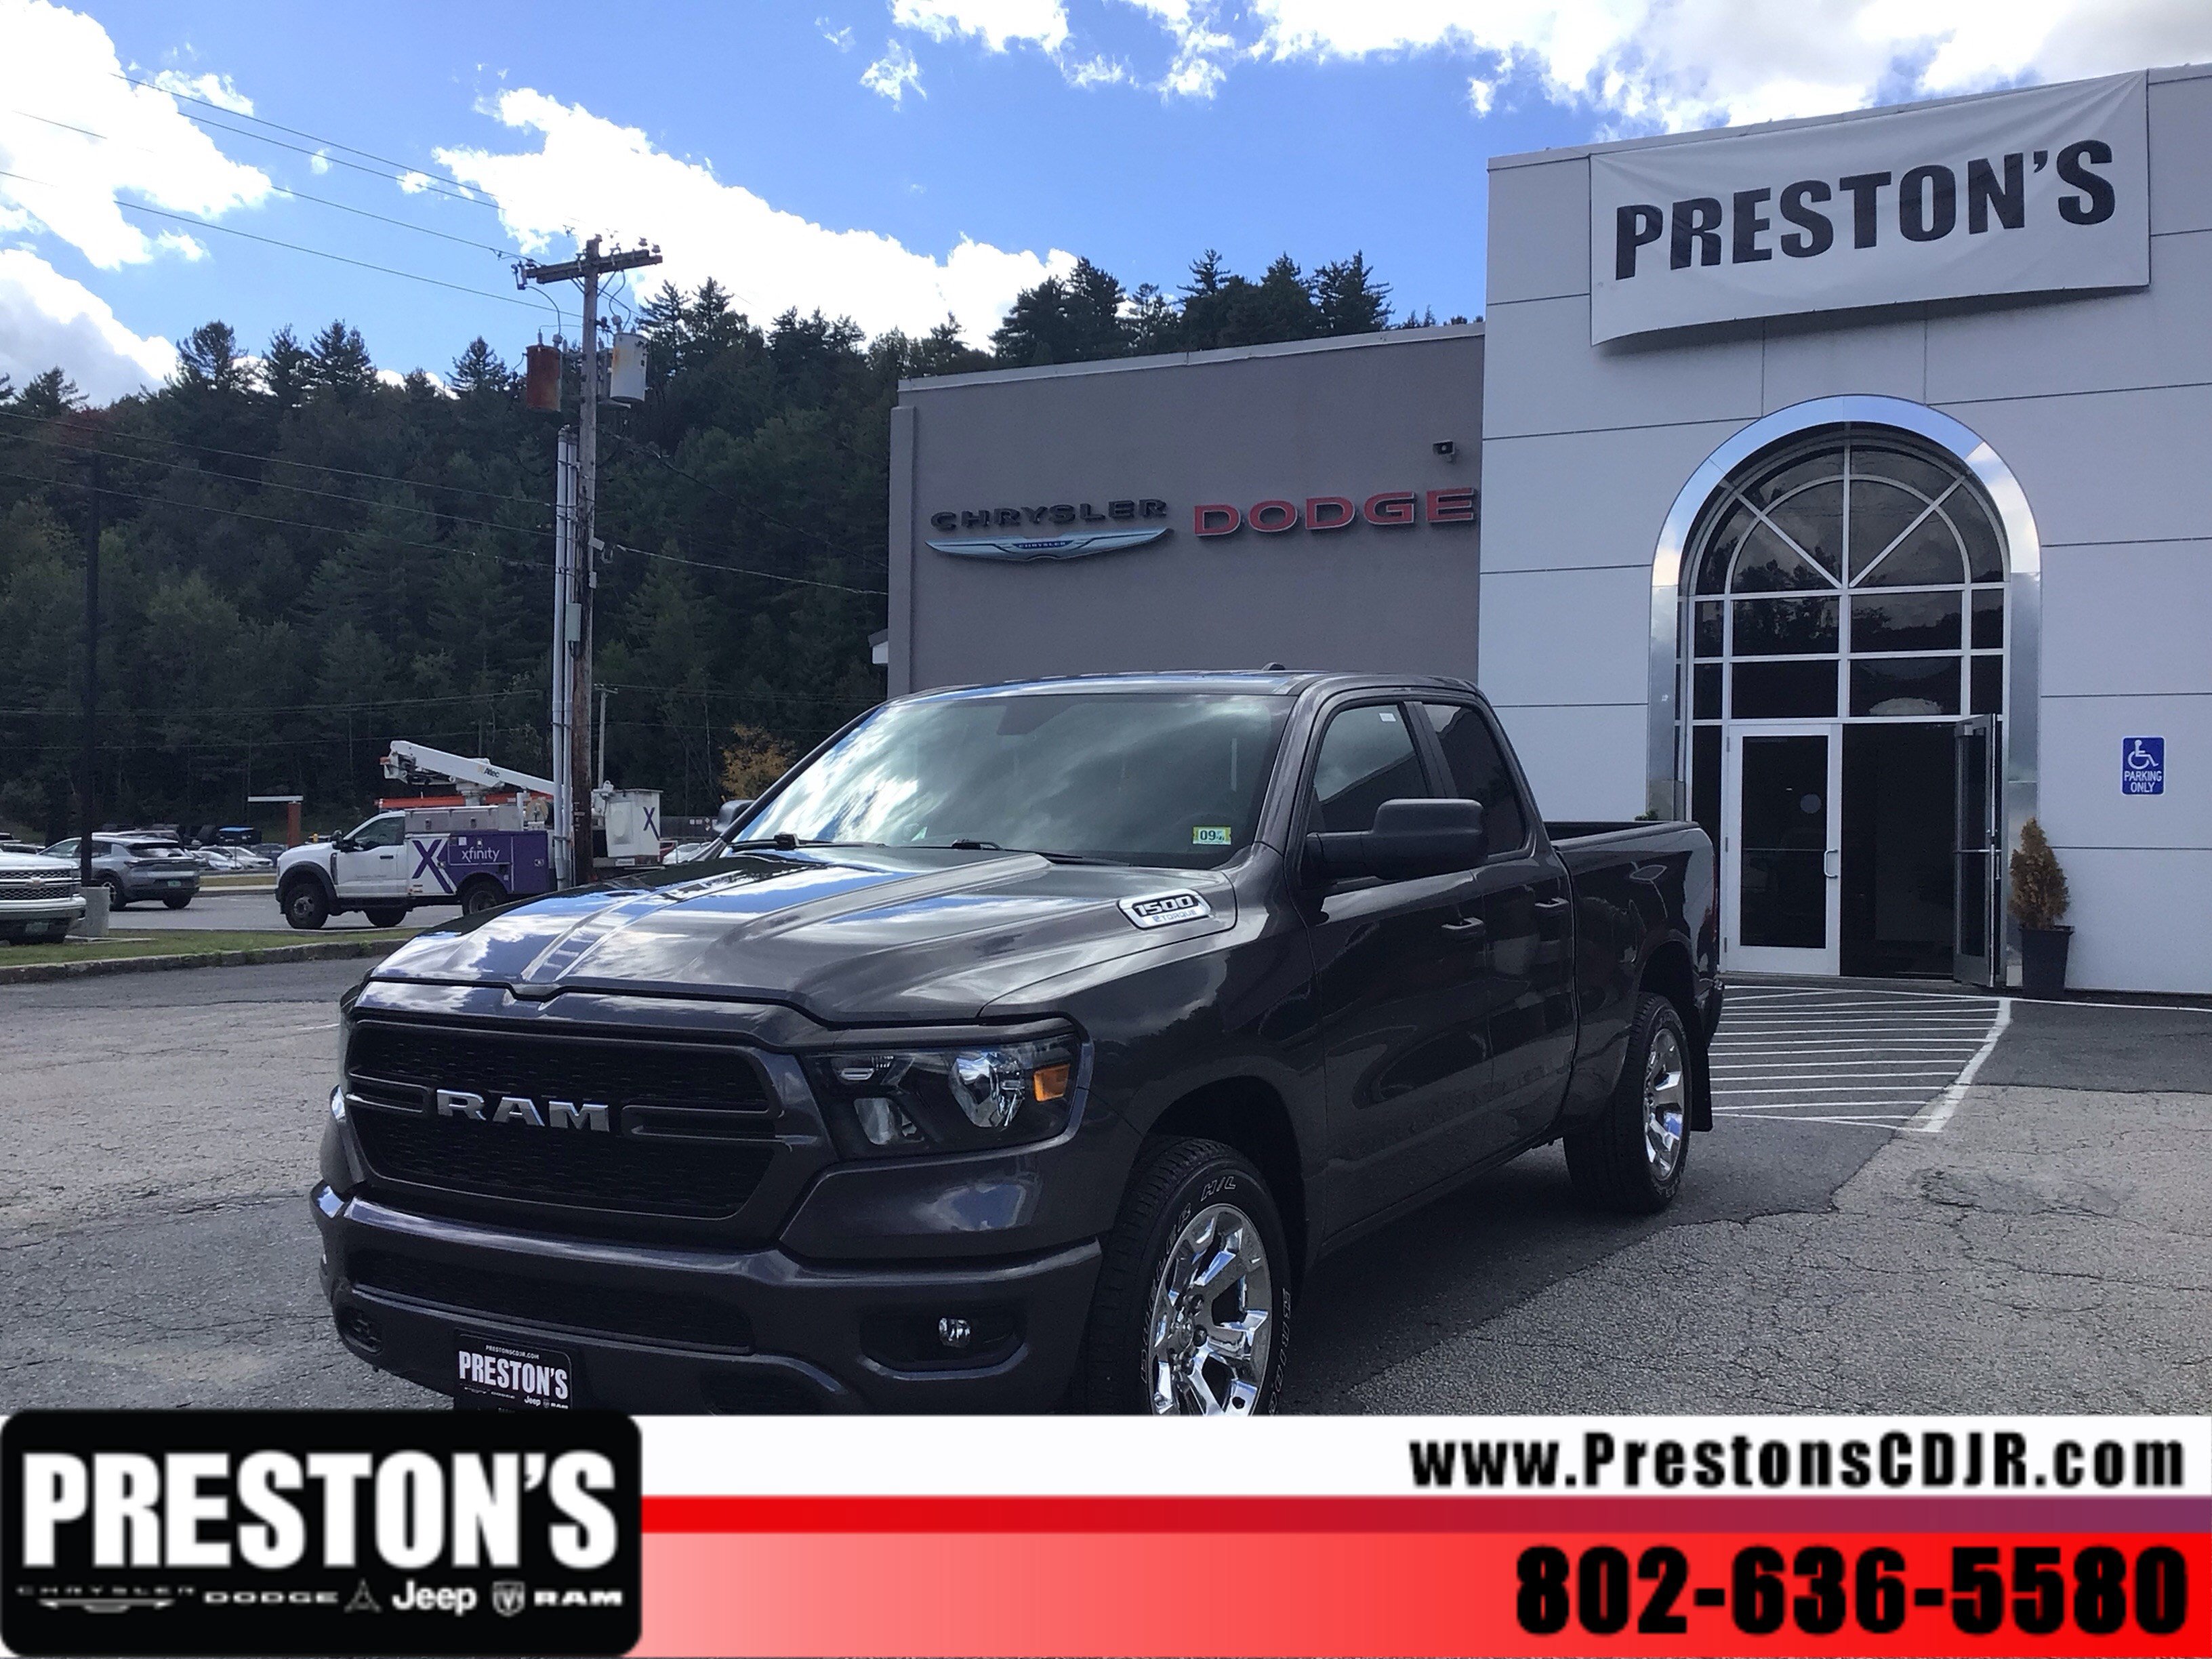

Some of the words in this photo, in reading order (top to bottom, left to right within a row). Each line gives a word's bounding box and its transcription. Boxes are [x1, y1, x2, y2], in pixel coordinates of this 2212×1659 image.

[1616, 140, 2115, 280] PRESTON'S
[930, 499, 1168, 531] CHRYSLER
[1194, 488, 1475, 536] DODGE
[2124, 771, 2163, 781] PARKING
[2131, 782, 2155, 792] ONLY
[462, 846, 500, 862] xfinity
[1134, 896, 1193, 915] 1500
[436, 1089, 609, 1132] RAM
[459, 1351, 568, 1399] PRESTON'S
[524, 1395, 541, 1407] Jeep
